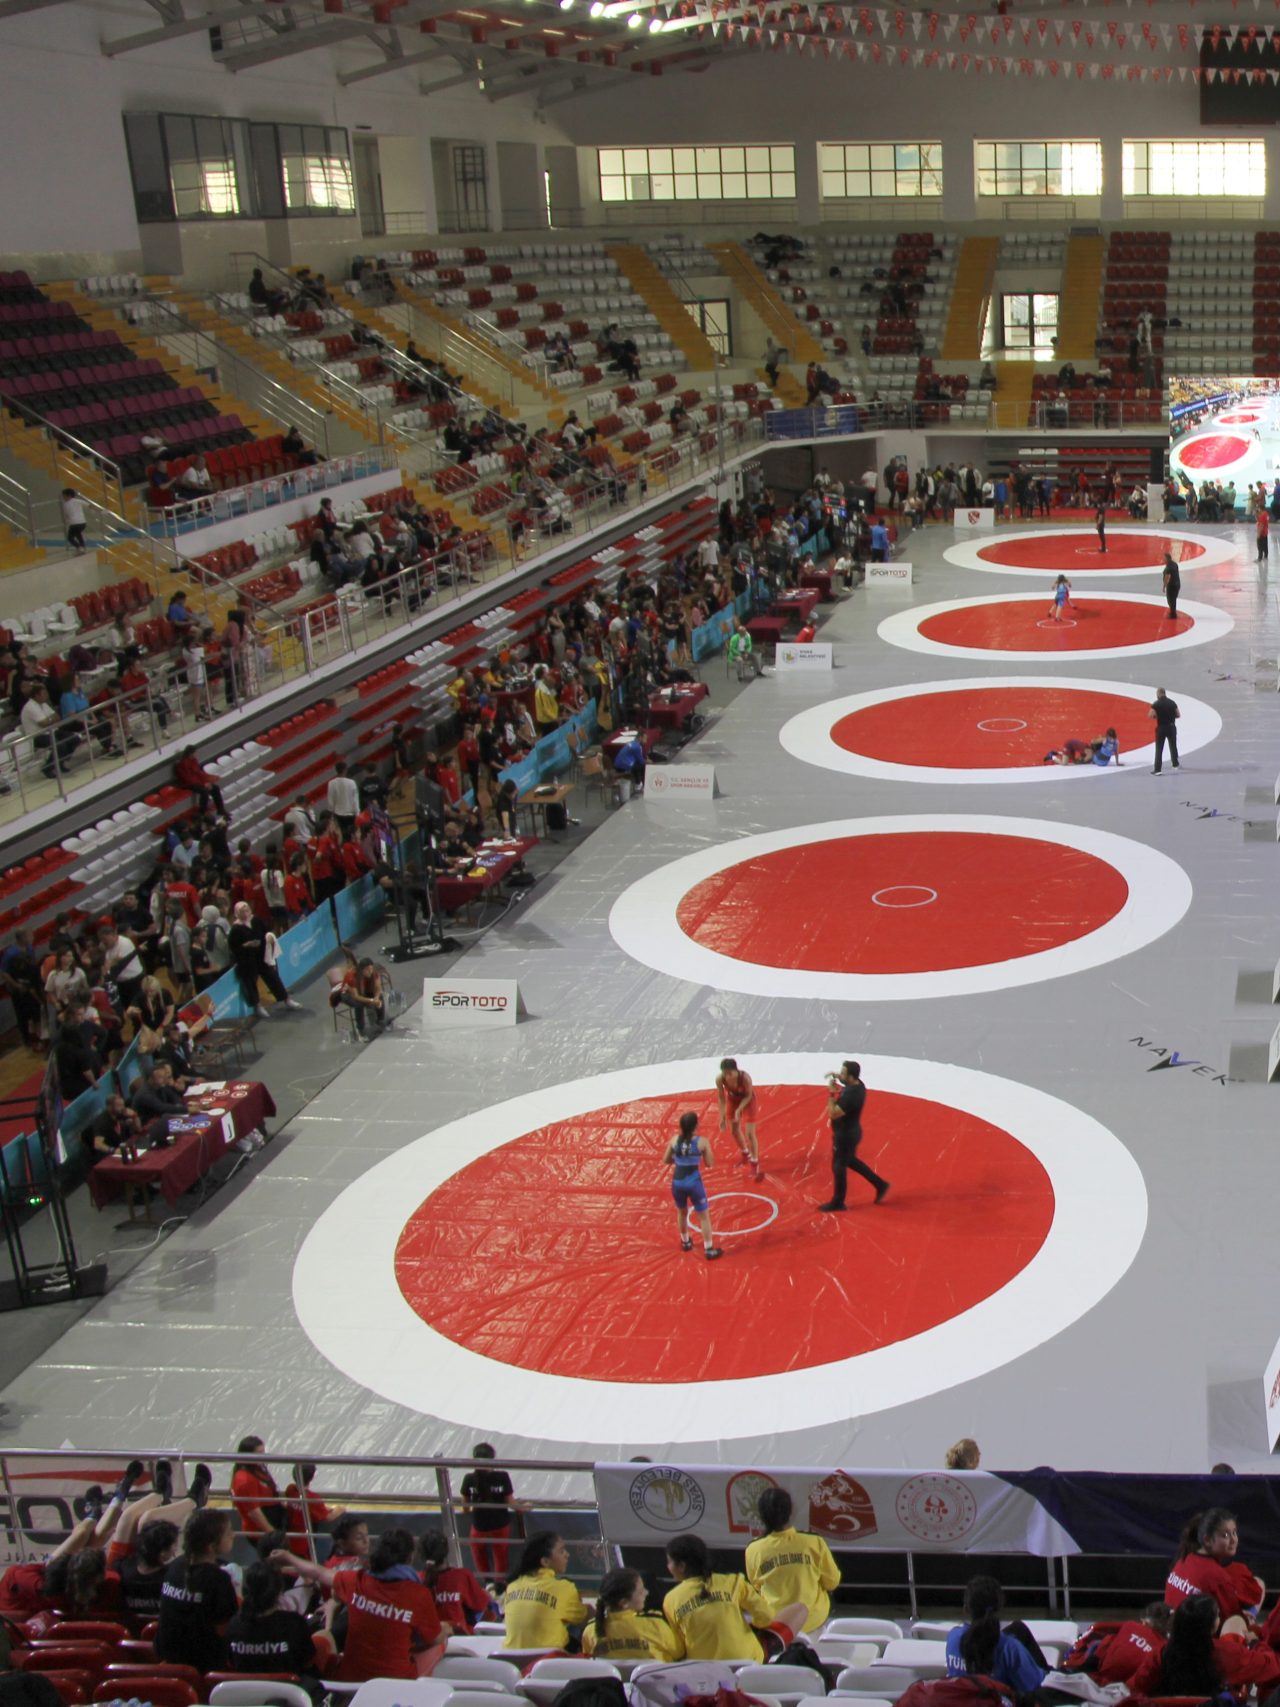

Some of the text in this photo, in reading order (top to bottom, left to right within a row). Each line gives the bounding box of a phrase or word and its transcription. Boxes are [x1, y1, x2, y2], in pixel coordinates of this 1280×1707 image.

[432, 995, 507, 1008] SPORTOTO
[161, 1581, 203, 1603] ÜRKİYE
[1168, 1571, 1201, 1595] ÜRKİYE
[351, 1592, 413, 1623] TÜRKİYE
[230, 1641, 289, 1655] TÜRKİYE
